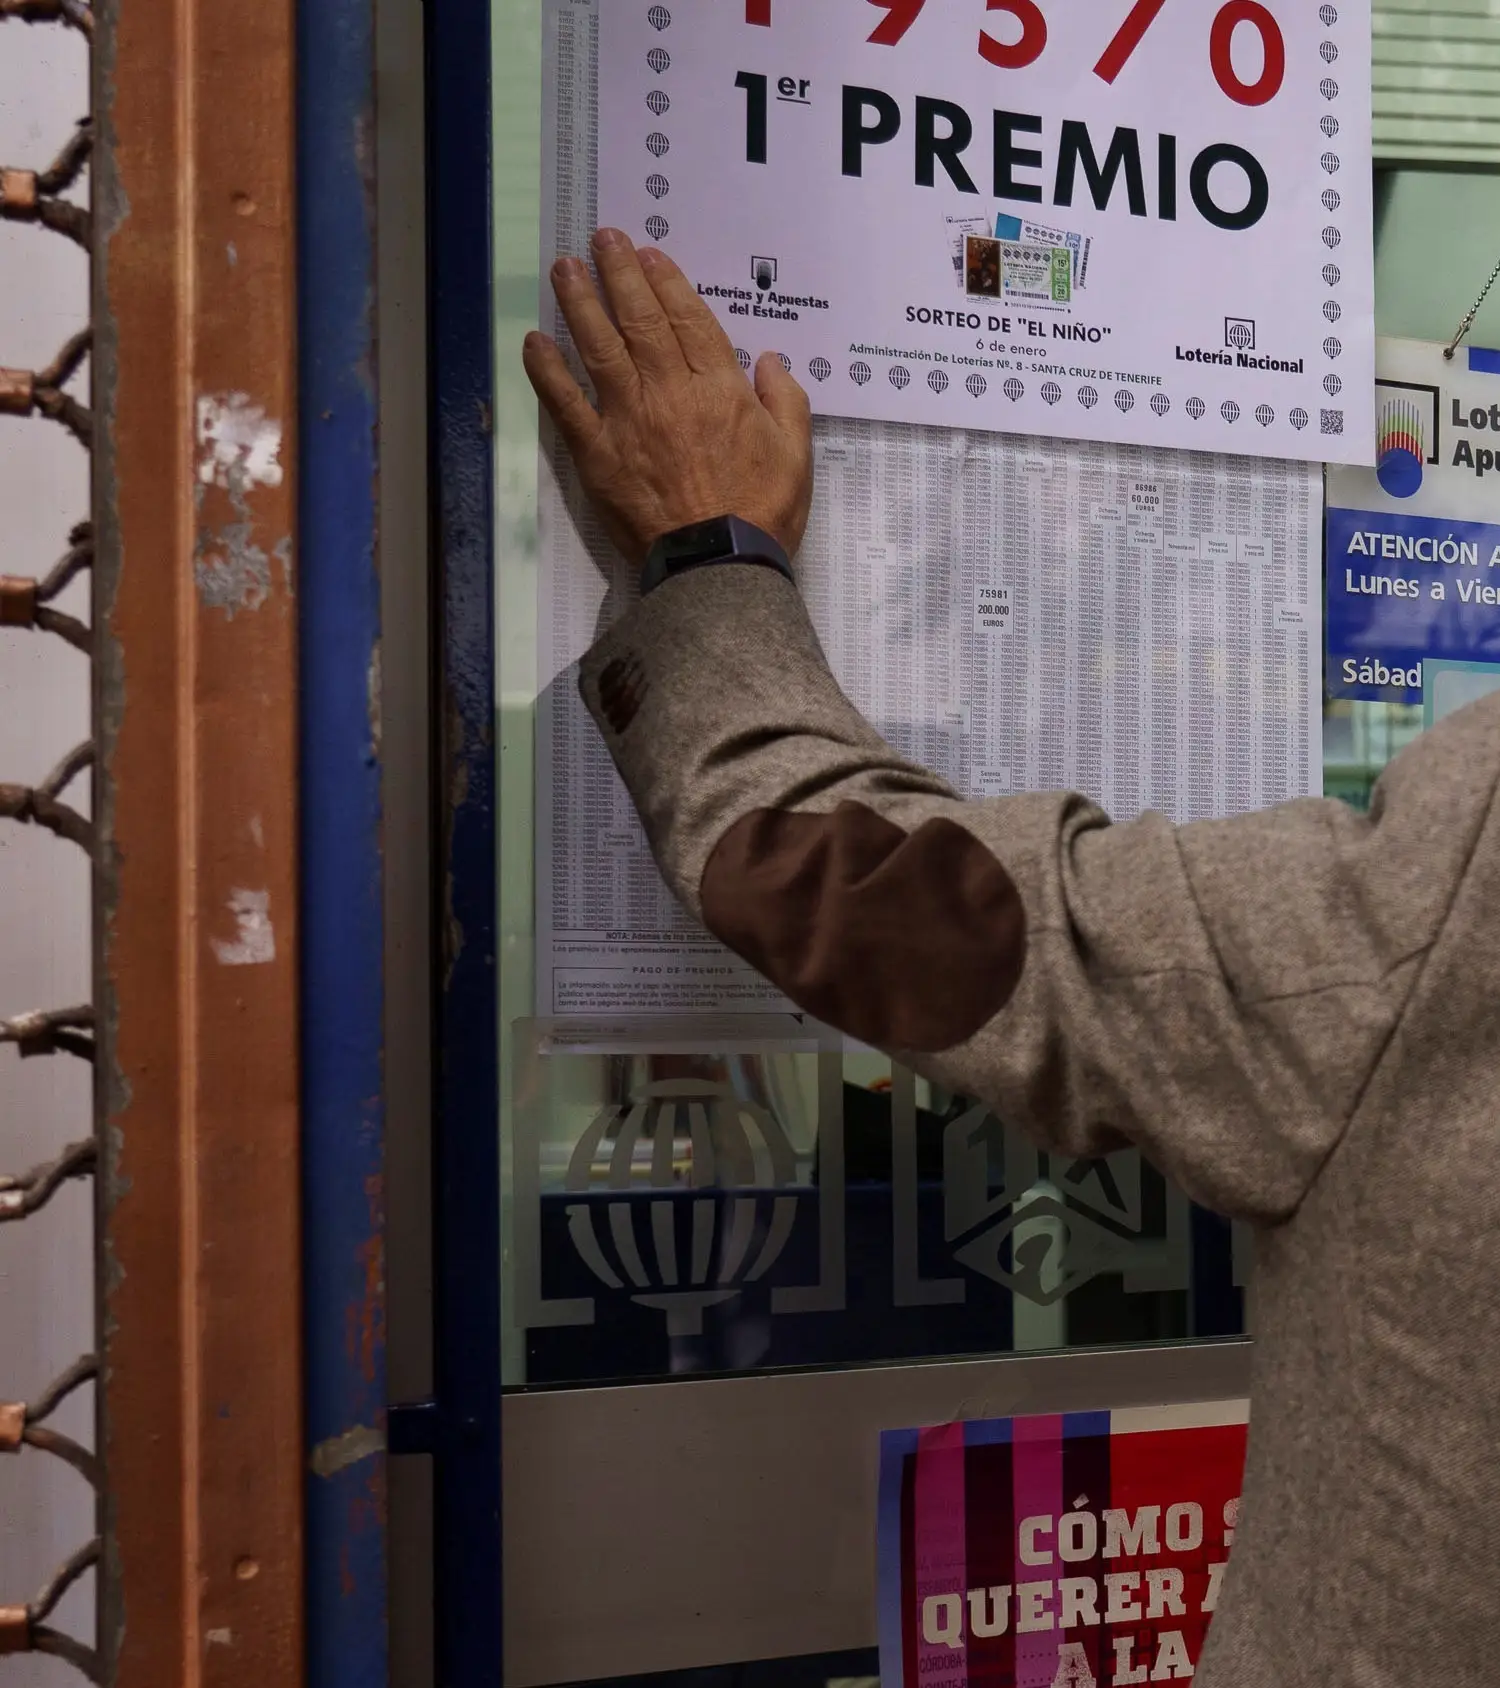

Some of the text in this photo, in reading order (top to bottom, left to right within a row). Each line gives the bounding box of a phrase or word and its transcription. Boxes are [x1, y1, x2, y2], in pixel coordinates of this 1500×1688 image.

[745, 0, 1285, 107] 570
[841, 84, 1269, 231] PREMIO
[697, 283, 829, 309] Loterías y Apuestas
[729, 303, 799, 321] del Estado
[906, 306, 1112, 343] SORTEO DE "EL NIÑO"
[976, 338, 1047, 357] 6 de enero
[1175, 346, 1304, 374] Lotería Nacional
[849, 343, 932, 362] Administración
[934, 351, 949, 363] De
[951, 355, 995, 368] Loterías
[1016, 361, 1023, 371] 8
[1031, 363, 1066, 377] SANTA
[1069, 367, 1097, 379] CRUZ
[1099, 370, 1113, 381] DE
[1115, 371, 1163, 386] TENERIFE
[1132, 495, 1159, 504] 60.000
[1347, 532, 1478, 565] ATENCIÓN
[980, 589, 1007, 599] 75981
[1346, 569, 1419, 598] Lunes
[1430, 581, 1445, 600] a
[978, 605, 1009, 615] 200.000
[1343, 659, 1423, 688] Sábad
[1019, 1493, 1204, 1566] CÓMO
[921, 1567, 1187, 1649] QUERER
[1049, 1629, 1196, 1688] A LA
